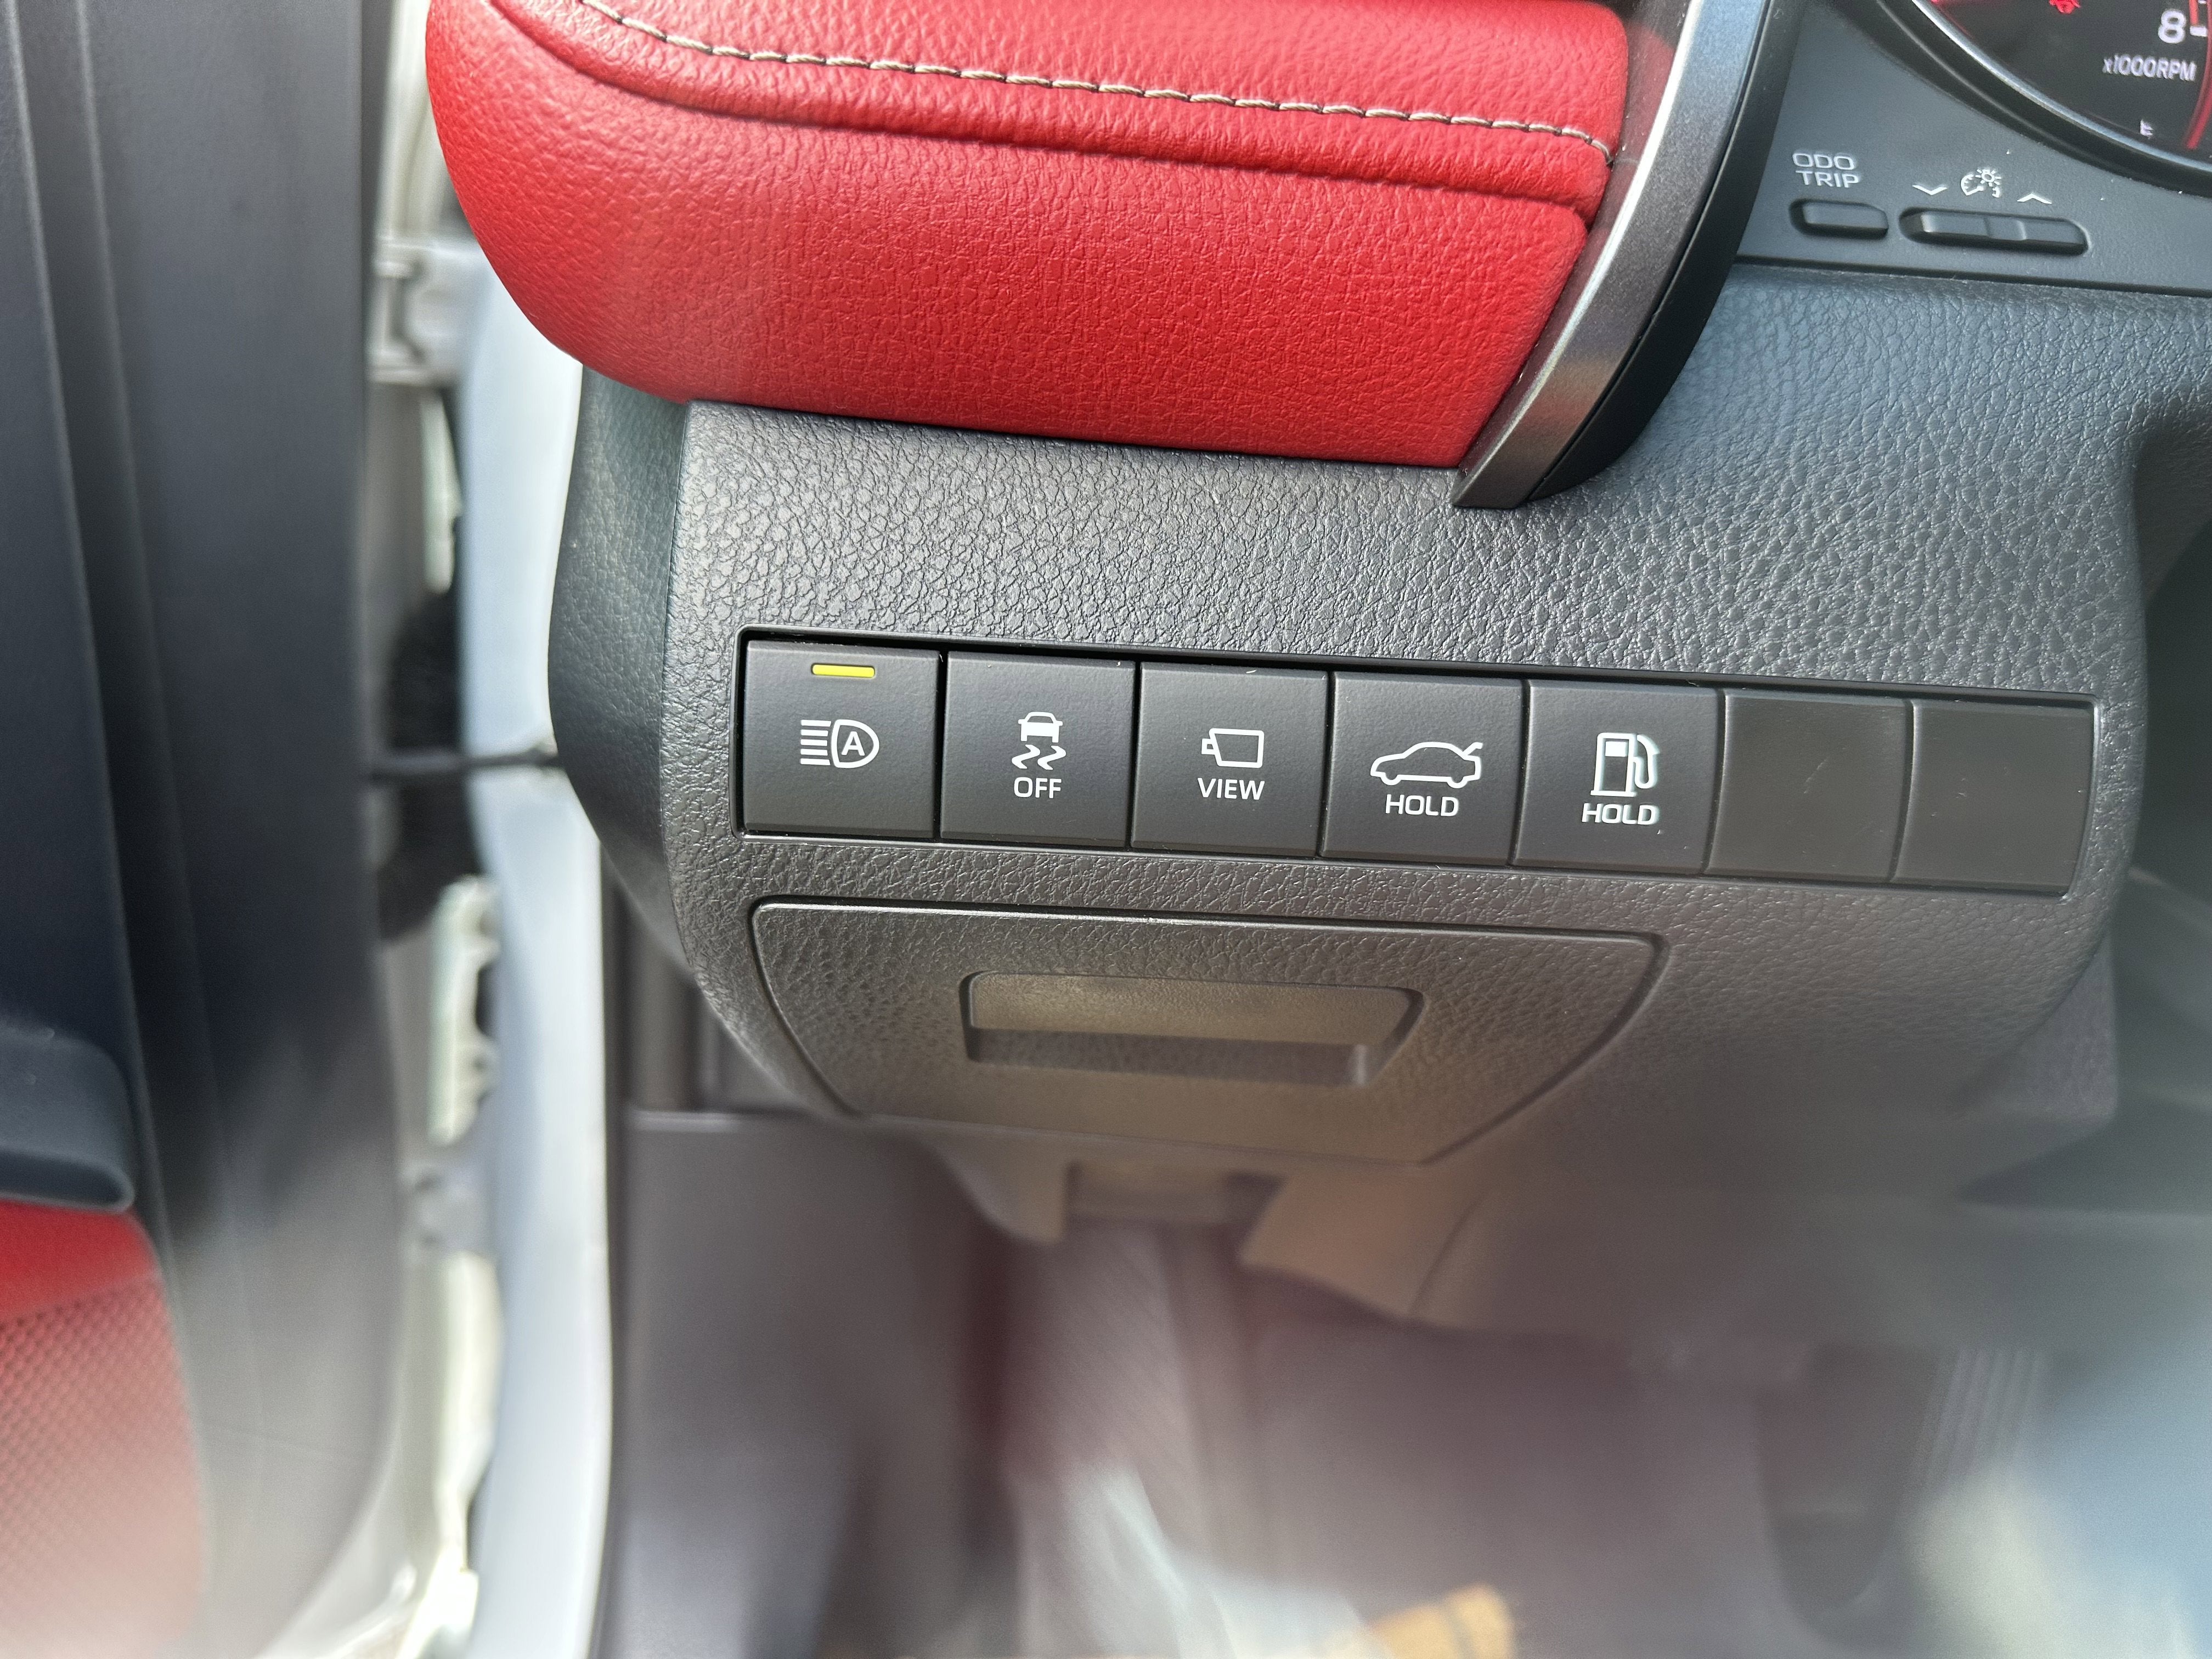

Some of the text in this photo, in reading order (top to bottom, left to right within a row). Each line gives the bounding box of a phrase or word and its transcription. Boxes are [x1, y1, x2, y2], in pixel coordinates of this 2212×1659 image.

[2158, 9, 2186, 43] 8
[2102, 54, 2197, 81] x1000RPM
[1793, 153, 1856, 170] ODO
[1796, 170, 1860, 188] TRIP
[841, 731, 865, 756] A
[1014, 776, 1062, 799] OFF
[1197, 777, 1265, 800] VIEW
[1385, 794, 1459, 817] HOLD
[1582, 803, 1660, 826] HOLD
